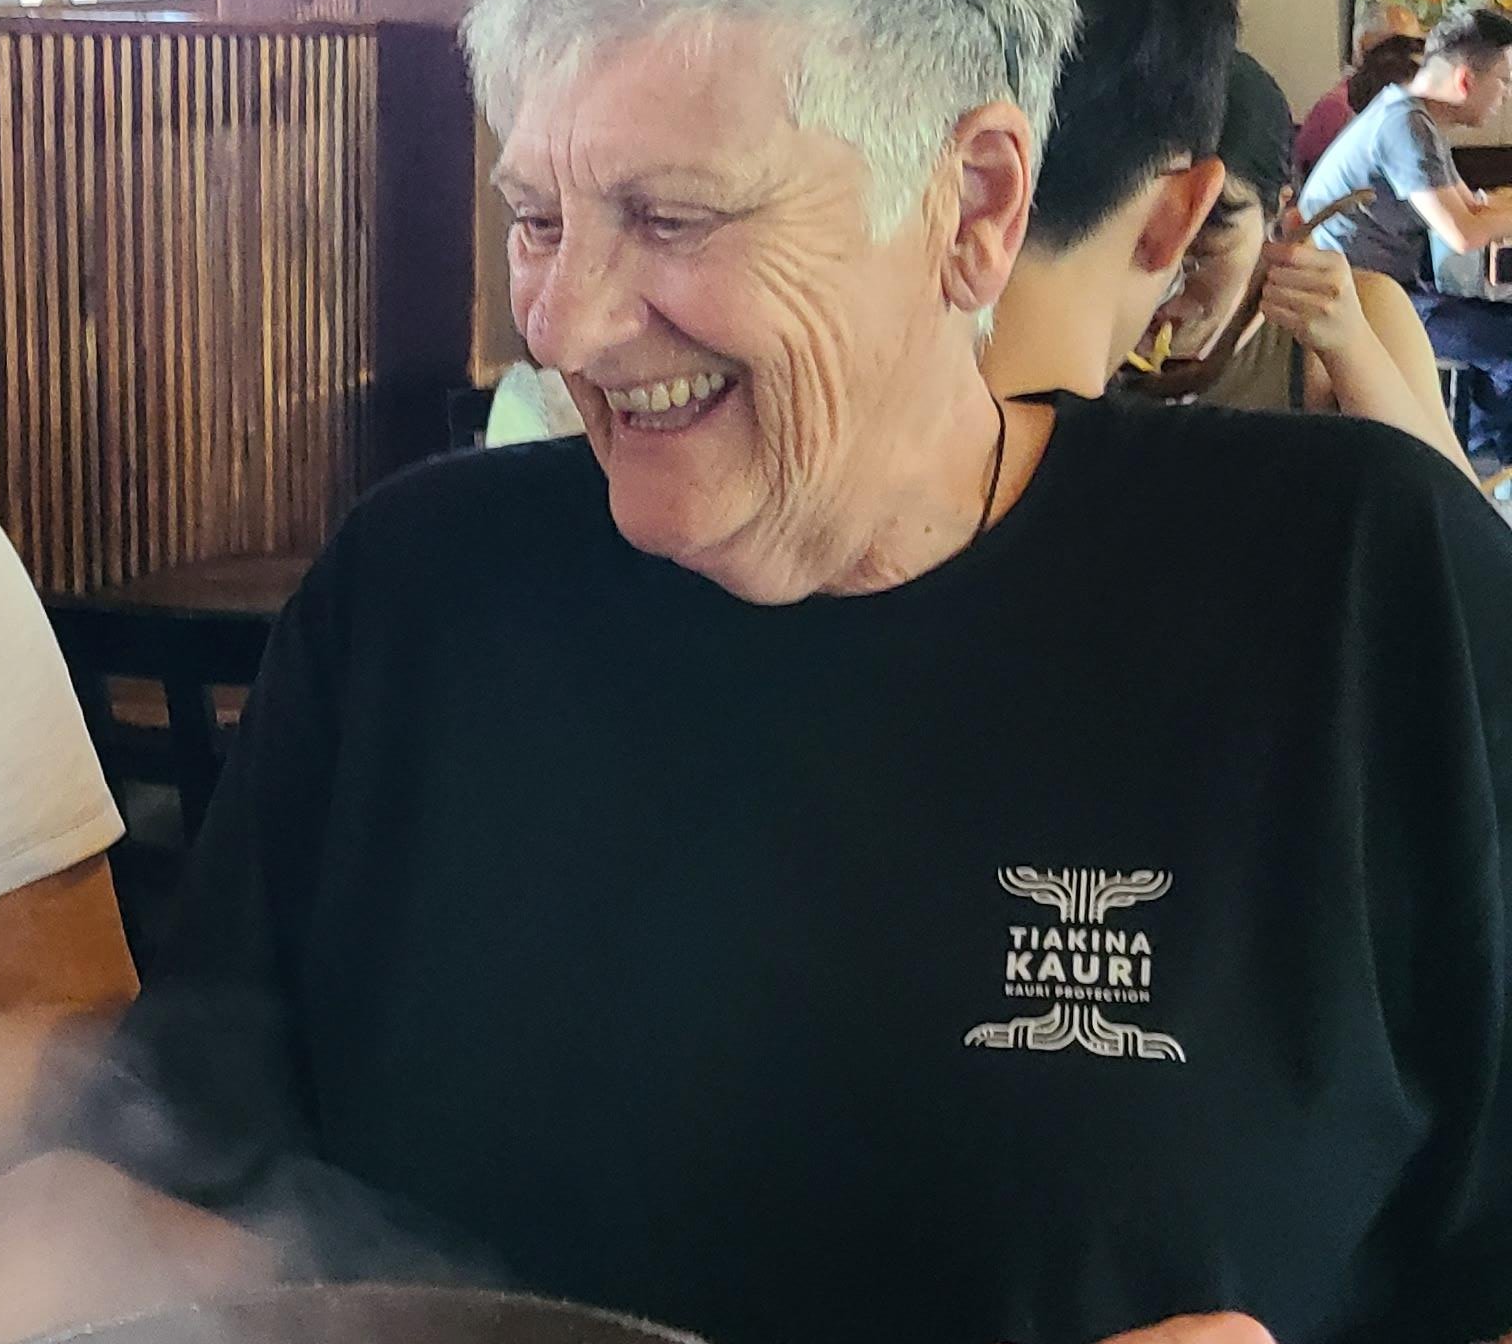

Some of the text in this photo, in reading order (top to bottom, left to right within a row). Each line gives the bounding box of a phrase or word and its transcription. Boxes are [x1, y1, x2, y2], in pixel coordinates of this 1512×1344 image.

[1009, 926, 1152, 955] TIAKINA
[1005, 950, 1152, 987] KAURI
[1004, 983, 1150, 1003] KAURI PROTECTION
